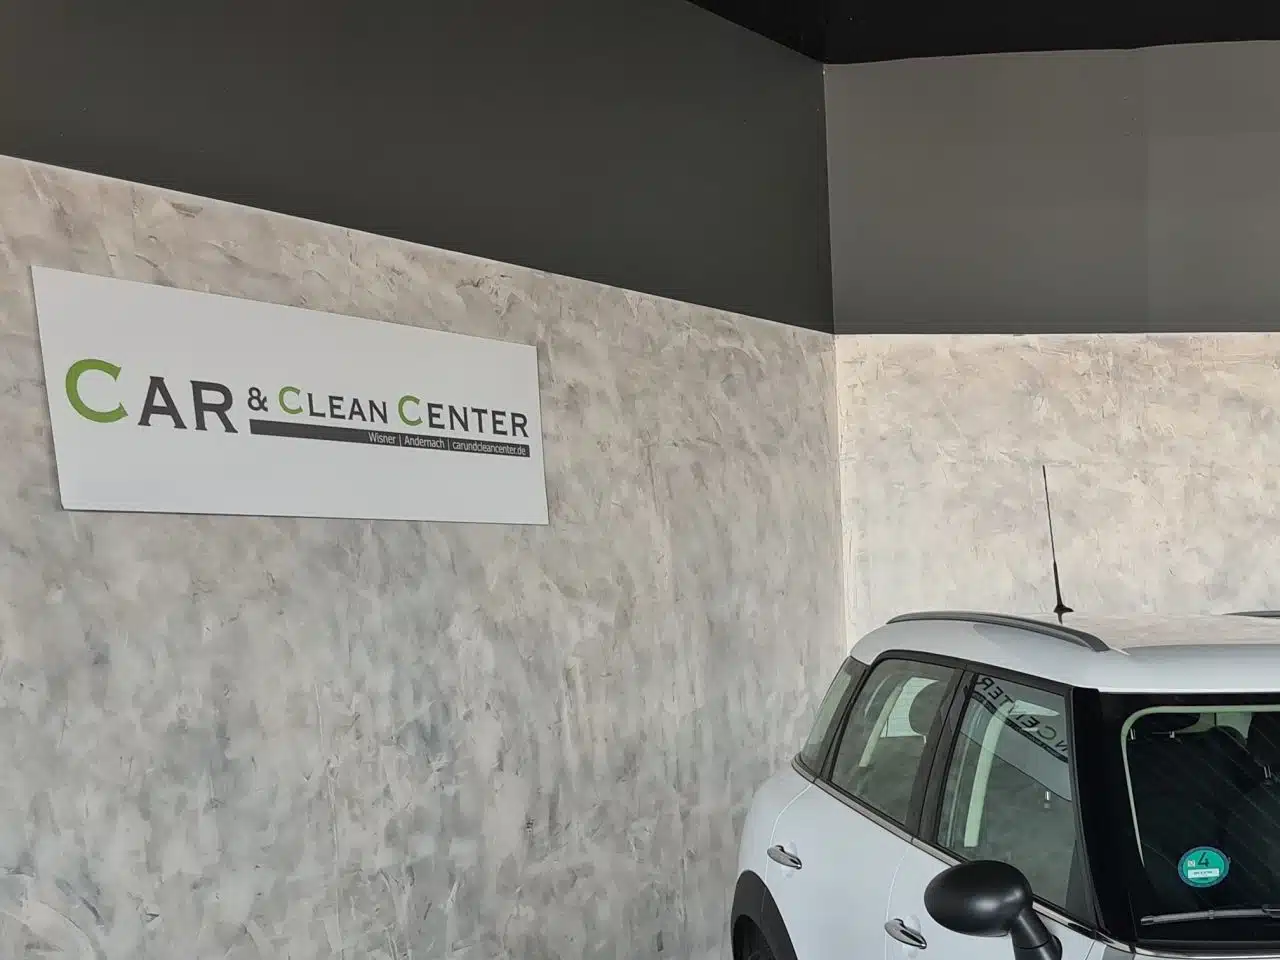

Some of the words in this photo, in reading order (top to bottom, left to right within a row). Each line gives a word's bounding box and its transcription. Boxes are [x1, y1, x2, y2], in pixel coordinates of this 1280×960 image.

[65, 358, 238, 433] CAR
[247, 386, 269, 412] &
[278, 386, 388, 424] CLEAN
[397, 395, 529, 438] CENTER
[368, 432, 396, 444] Wisner
[404, 435, 445, 449] Andernach
[452, 441, 526, 456] carundcleancenter.de
[1197, 852, 1210, 867] 4
